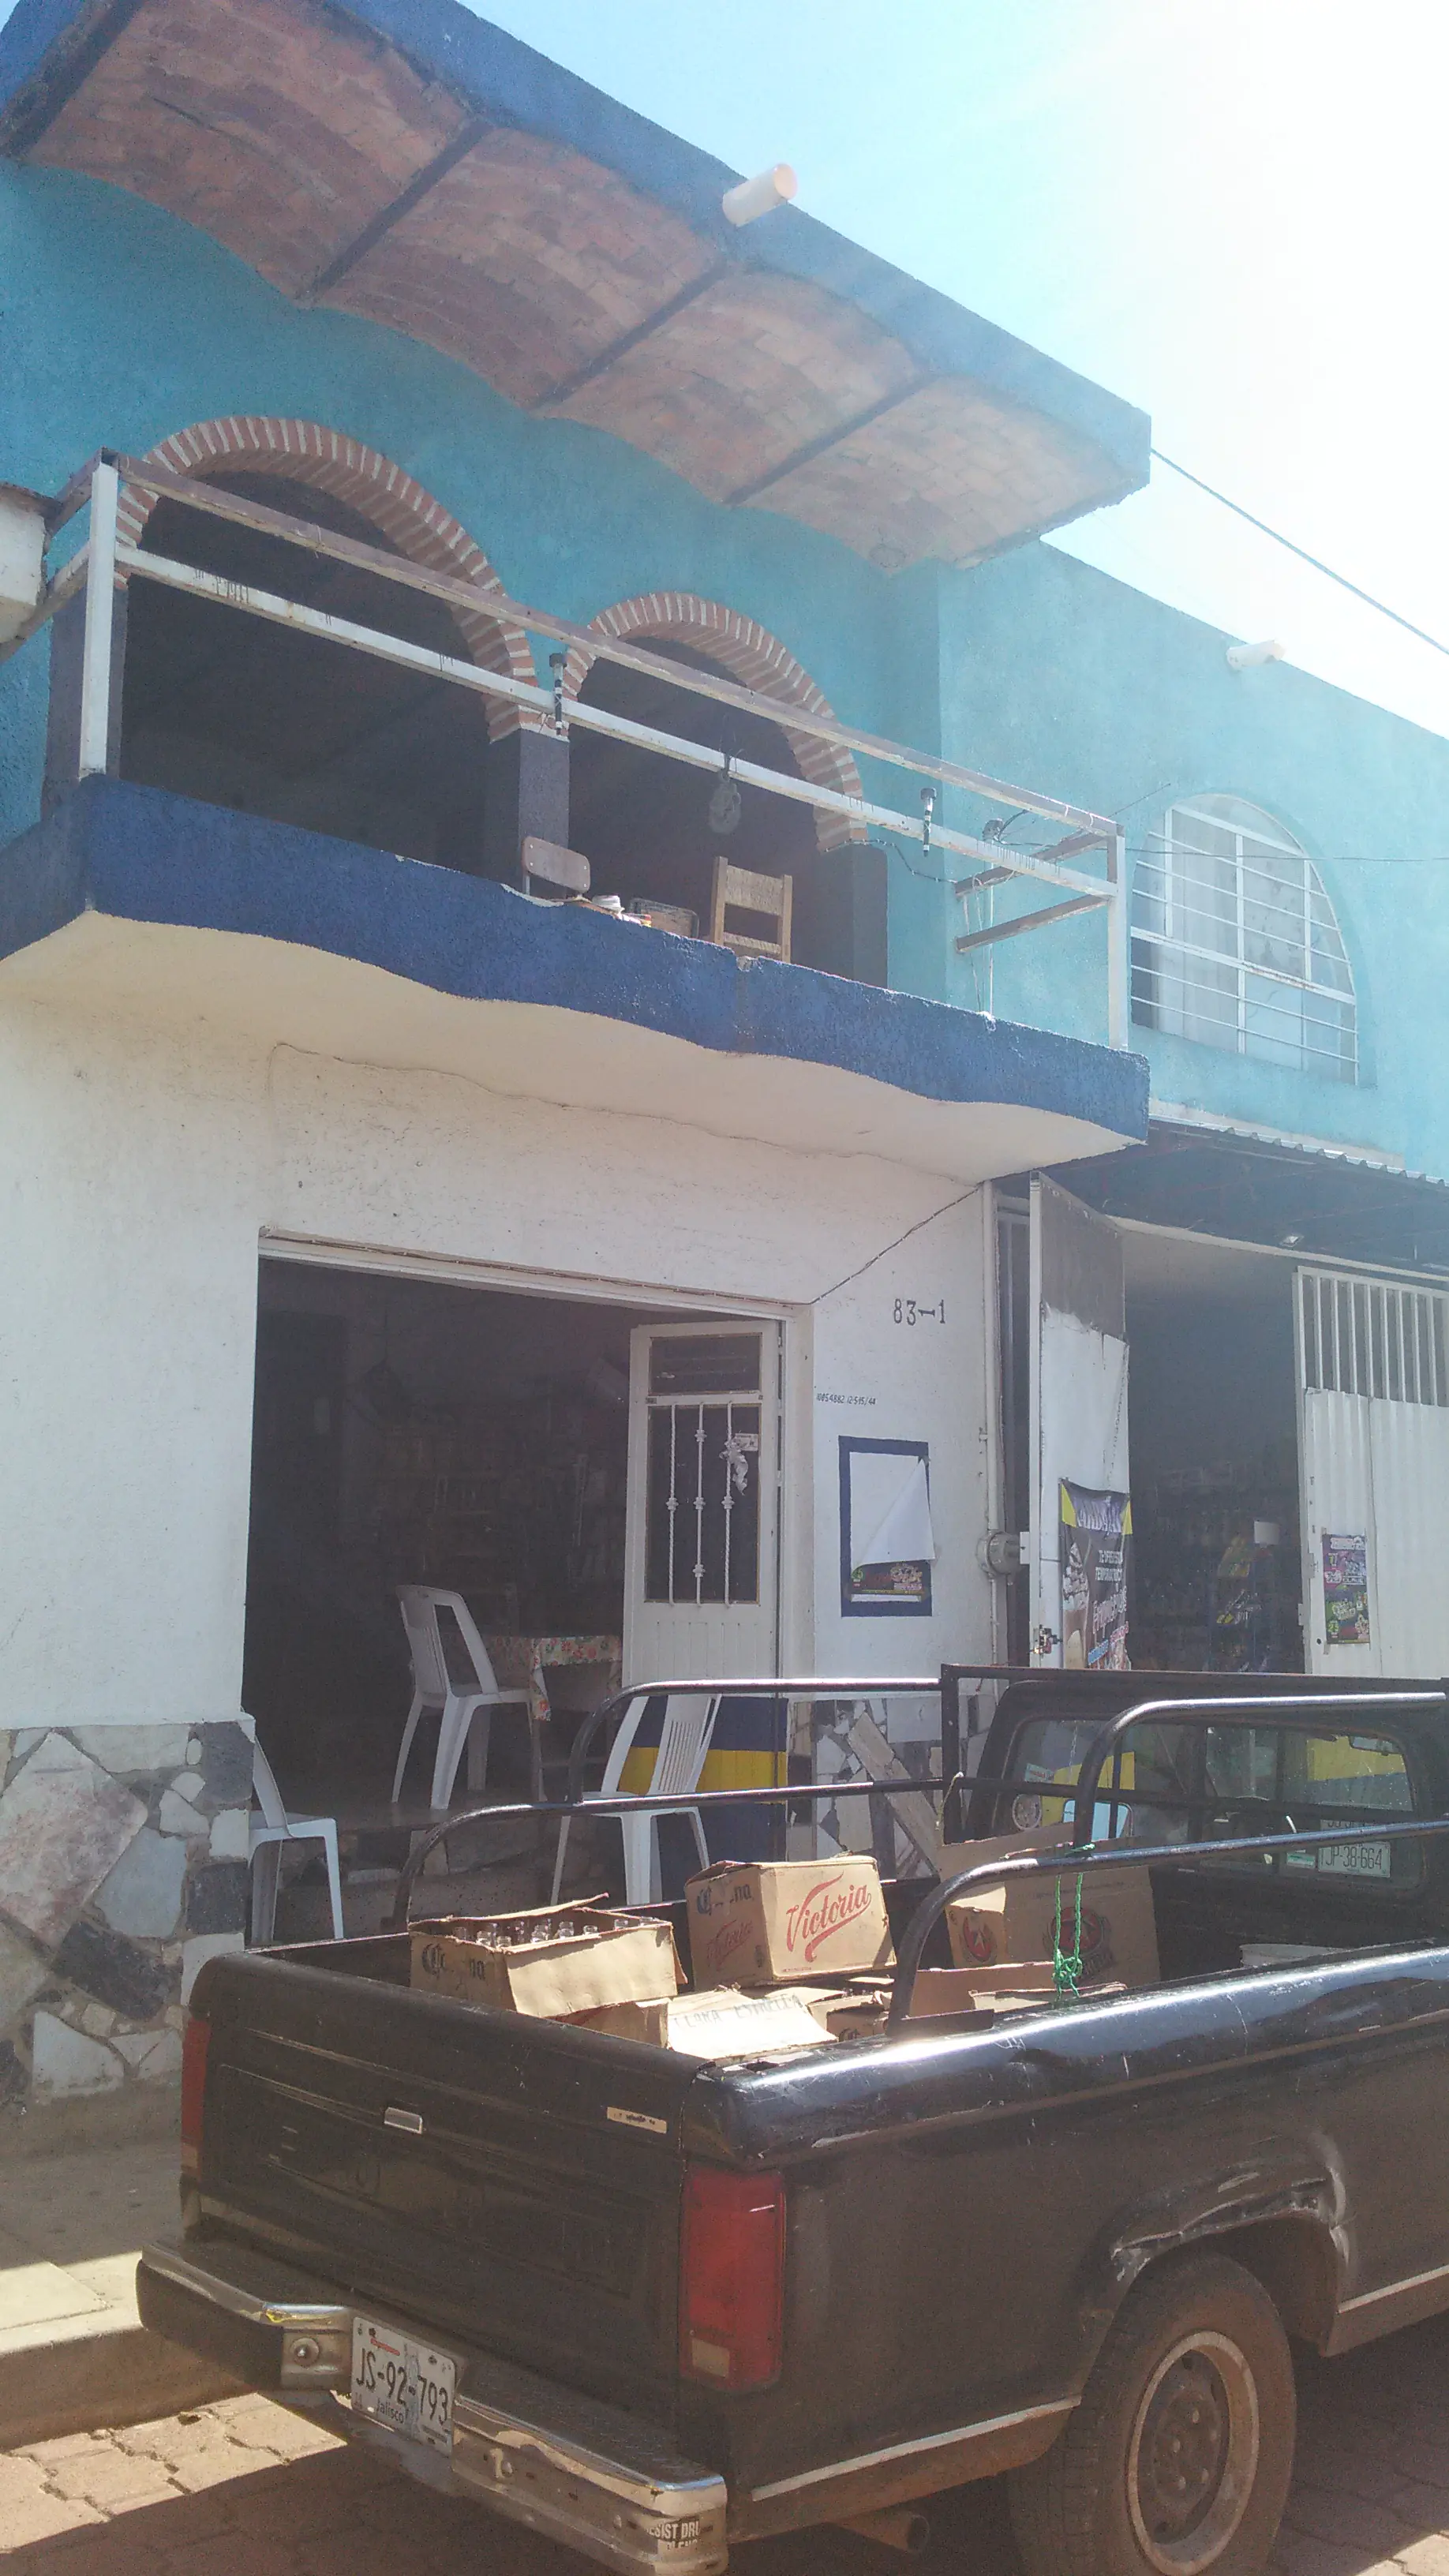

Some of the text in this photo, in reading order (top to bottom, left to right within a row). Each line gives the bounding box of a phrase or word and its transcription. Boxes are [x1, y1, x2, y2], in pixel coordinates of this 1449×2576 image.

[893, 1298, 946, 1326] 83-1
[785, 1870, 872, 1963] Victoria
[356, 2348, 448, 2425] JS-92-793
[376, 2397, 404, 2424] Jalisco
